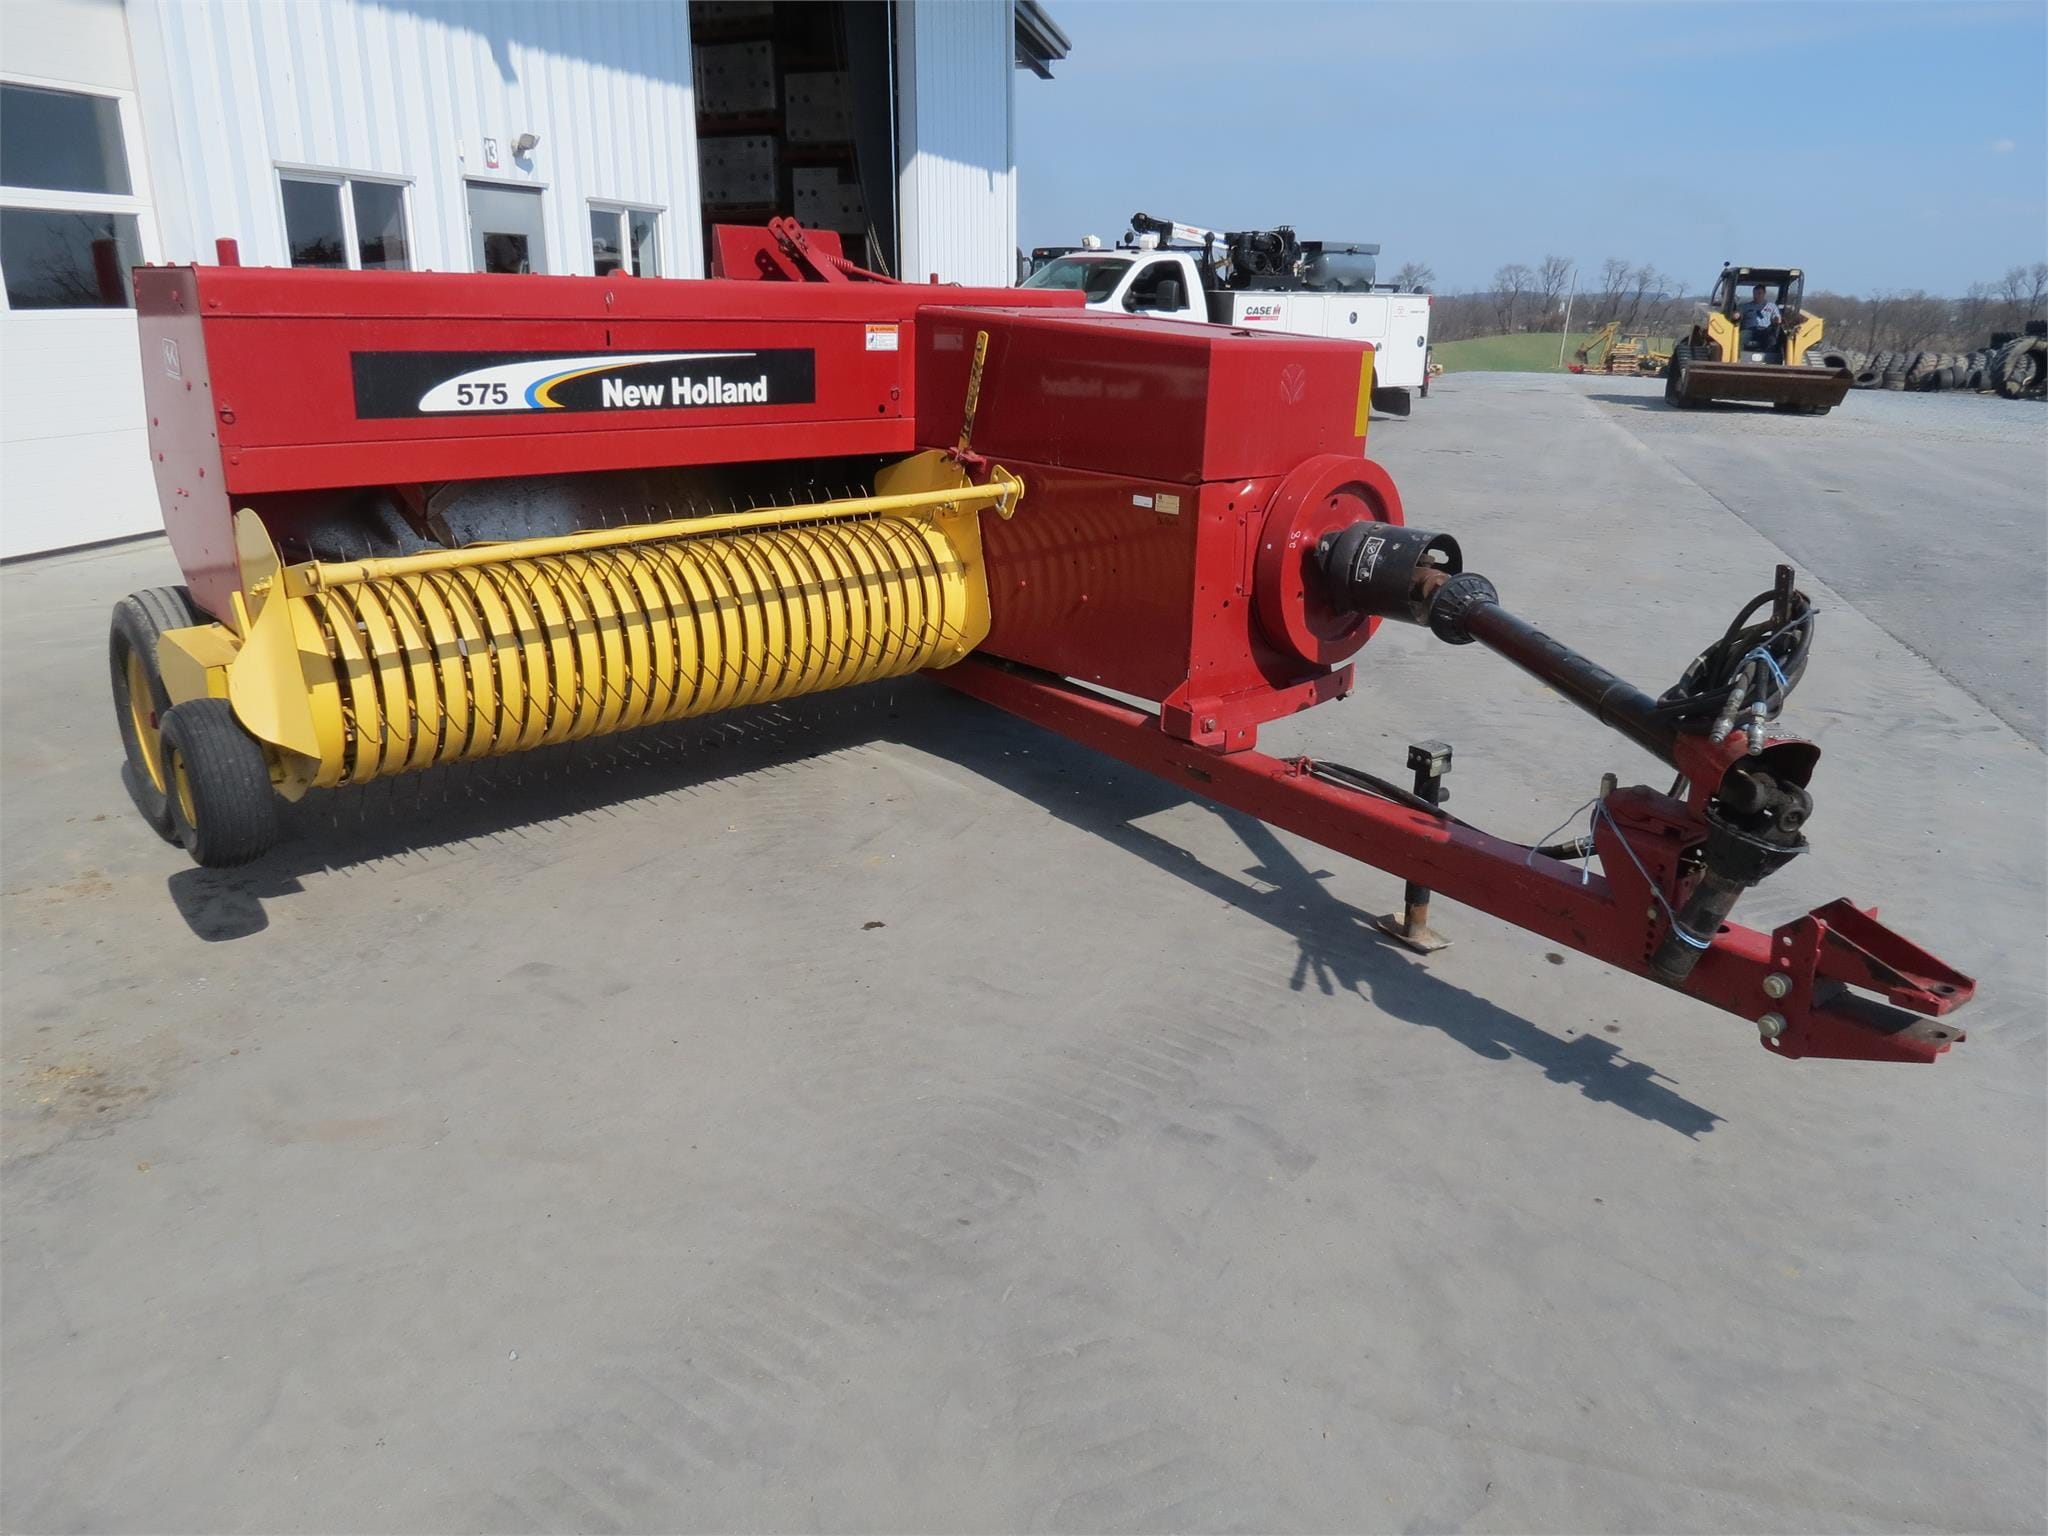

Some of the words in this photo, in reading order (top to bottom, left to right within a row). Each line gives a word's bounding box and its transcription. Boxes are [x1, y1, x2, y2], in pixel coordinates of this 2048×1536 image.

[1246, 306, 1272, 315] CASE
[457, 383, 509, 406] 575
[602, 378, 664, 407] New
[671, 375, 767, 405] Holland
